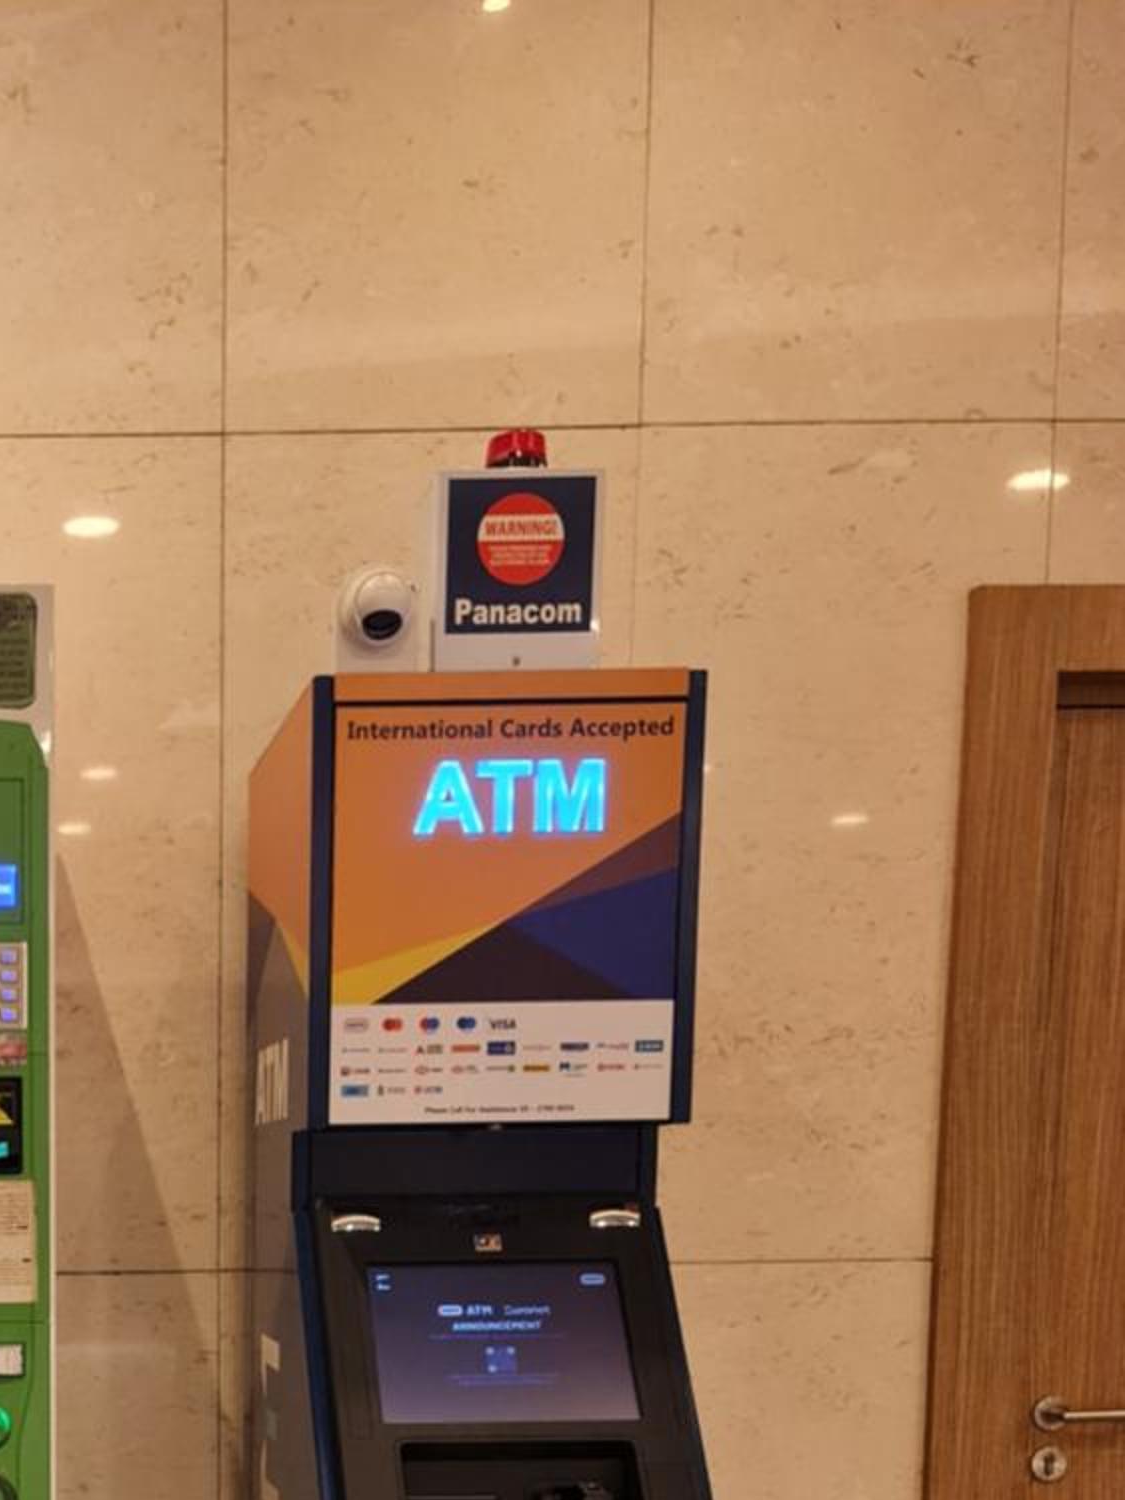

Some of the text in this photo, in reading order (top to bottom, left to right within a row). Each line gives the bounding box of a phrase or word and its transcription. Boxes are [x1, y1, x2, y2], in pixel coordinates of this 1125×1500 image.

[454, 597, 583, 626] Panacom
[347, 716, 674, 743] International Cards Accepted
[413, 757, 606, 836] ATM
